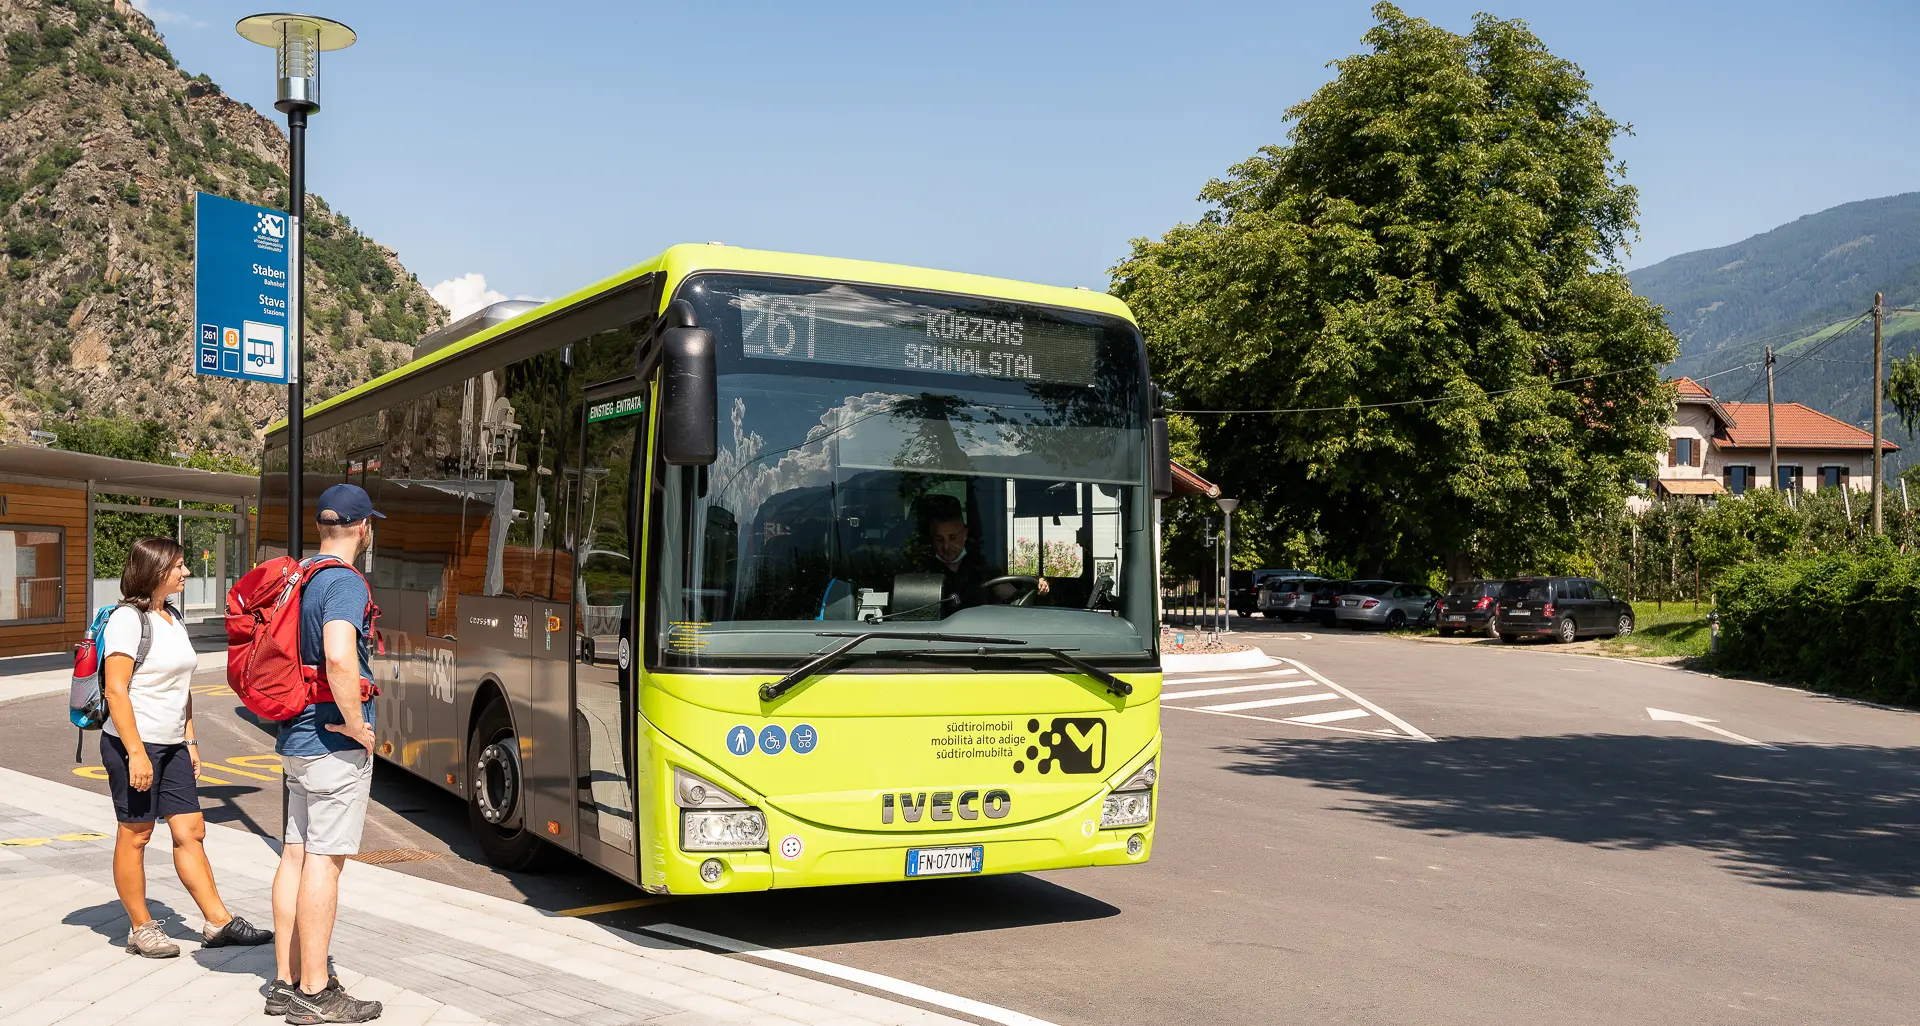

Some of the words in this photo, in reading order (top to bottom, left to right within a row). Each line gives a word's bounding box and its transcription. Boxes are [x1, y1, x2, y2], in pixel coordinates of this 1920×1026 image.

[252, 263, 285, 280] Staben
[264, 279, 285, 288] Bahnhof
[259, 293, 285, 309] Stava
[263, 308, 285, 317] Stazione
[742, 294, 816, 358] 261
[926, 312, 1024, 346] KURZRAS
[203, 330, 216, 341] 261
[203, 354, 216, 364] 267
[904, 343, 1041, 379] SCHNALSTAL
[590, 402, 613, 419] EINSTIEG
[616, 396, 641, 413] ENTRATA
[946, 721, 1013, 732] südtirolmobil
[931, 735, 973, 746] mobilità
[976, 734, 996, 745] alto
[998, 734, 1026, 746] adige
[936, 747, 1013, 759] südtirolmubiltà
[881, 789, 1012, 824] IVECO
